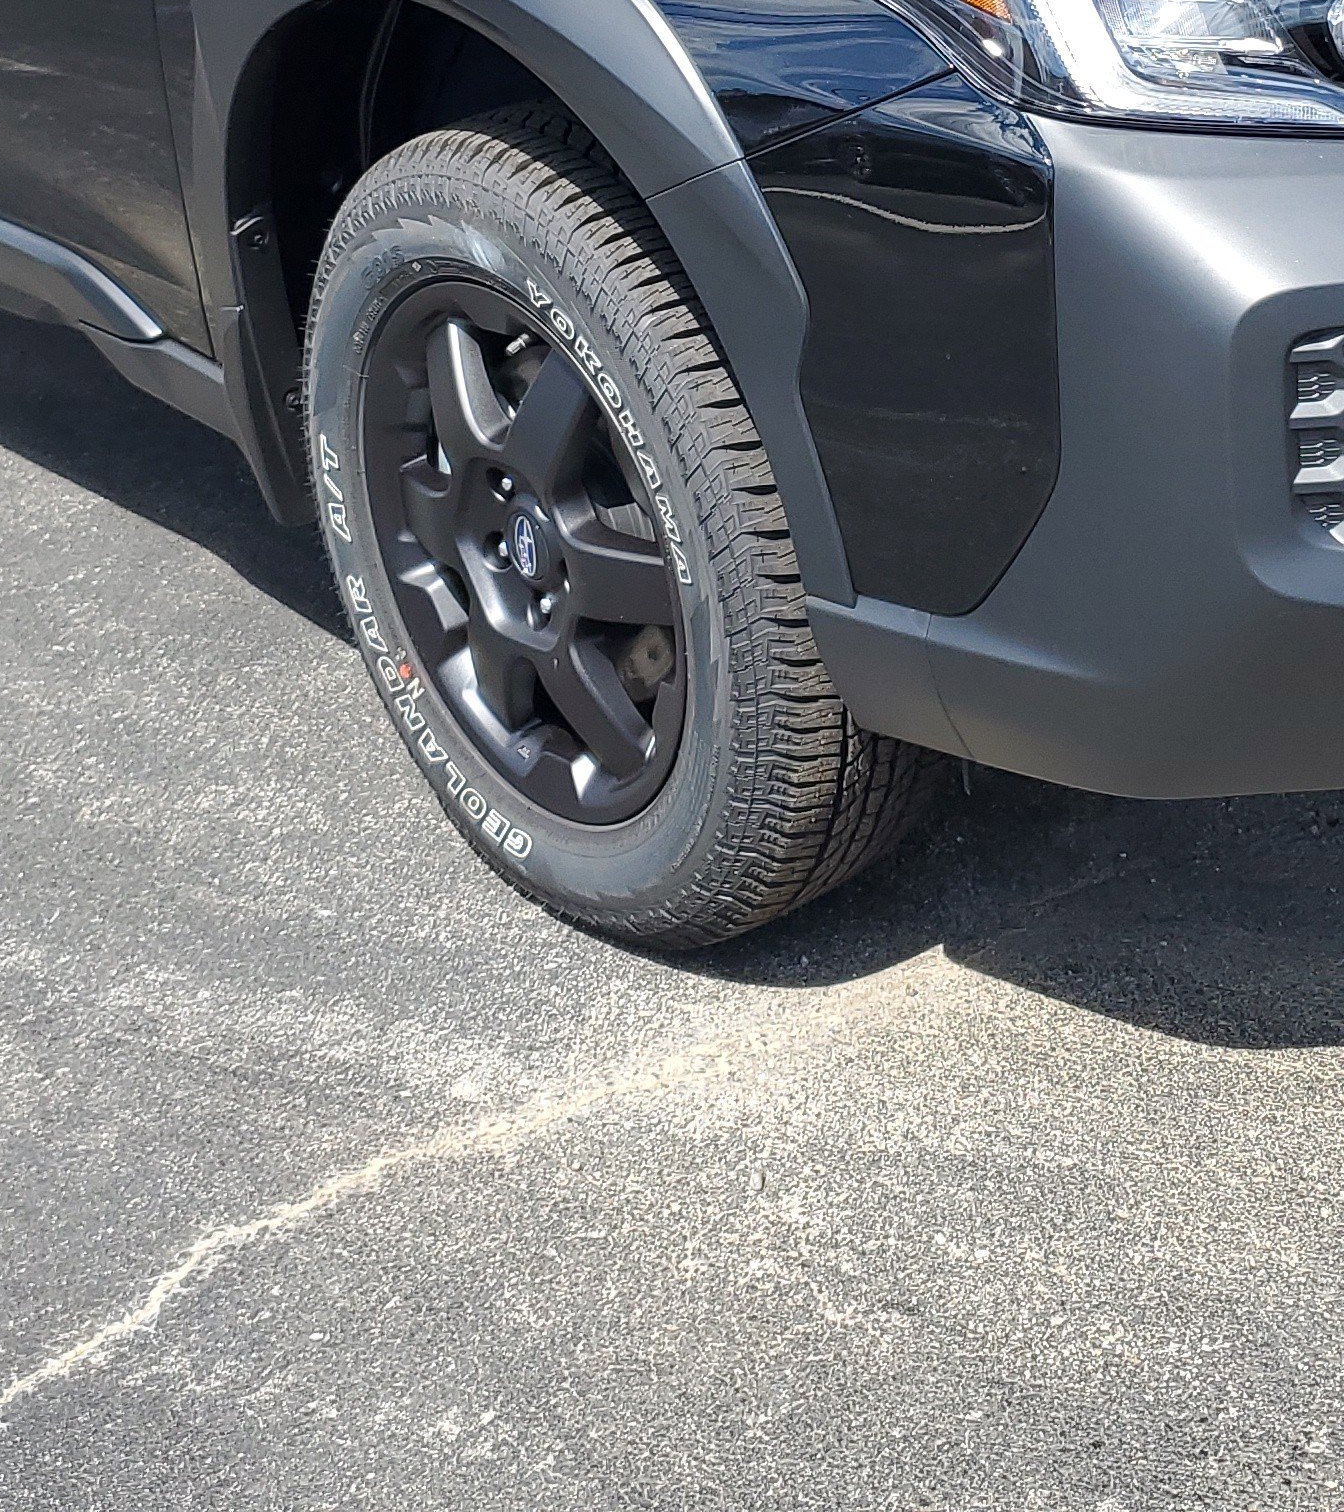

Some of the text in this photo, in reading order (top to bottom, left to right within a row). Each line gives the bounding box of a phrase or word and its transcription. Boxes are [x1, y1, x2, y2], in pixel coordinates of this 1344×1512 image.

[525, 277, 692, 585] YOKOHAMA
[319, 433, 533, 859] GEOLANDAR A/T
